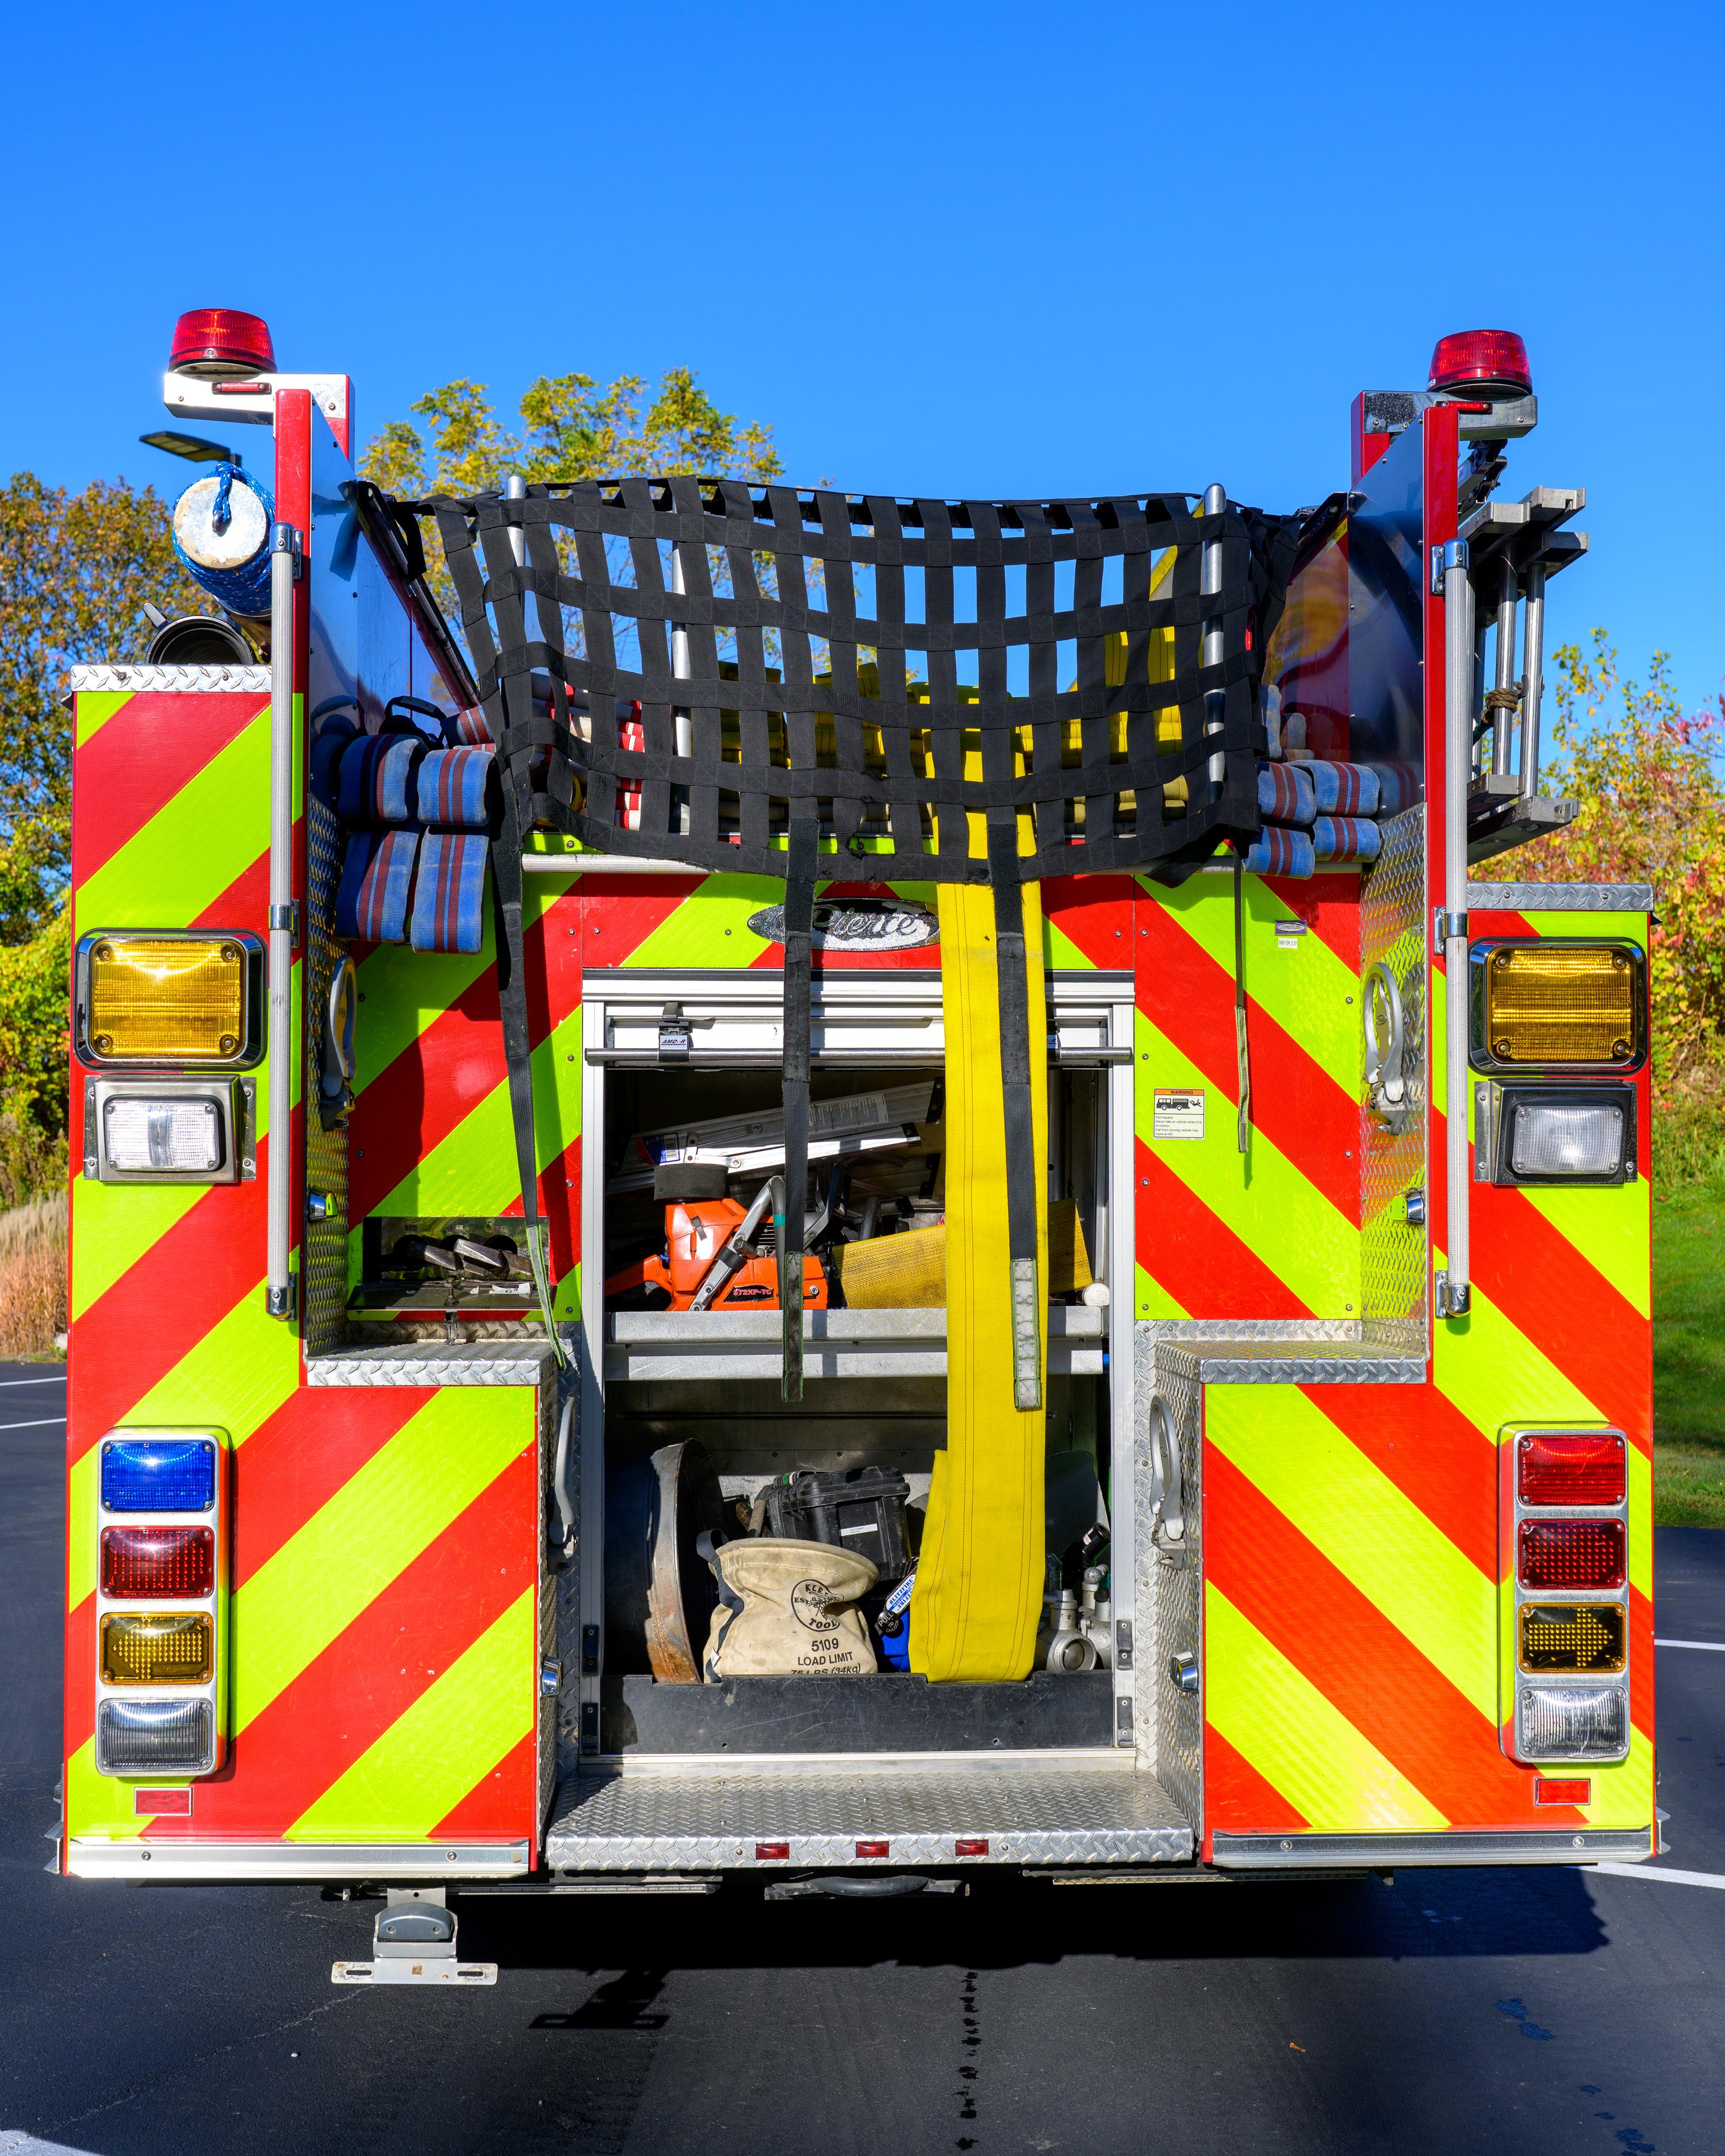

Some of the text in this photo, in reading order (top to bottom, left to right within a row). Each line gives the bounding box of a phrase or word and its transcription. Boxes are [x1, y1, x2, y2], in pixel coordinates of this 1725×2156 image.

[805, 1584, 829, 1595] KLE
[889, 1578, 914, 1605] BLITZFIRE
[878, 1612, 894, 1627] PULL
[811, 1637, 839, 1652] 5109
[798, 1651, 853, 1666] LOAD LIMIT
